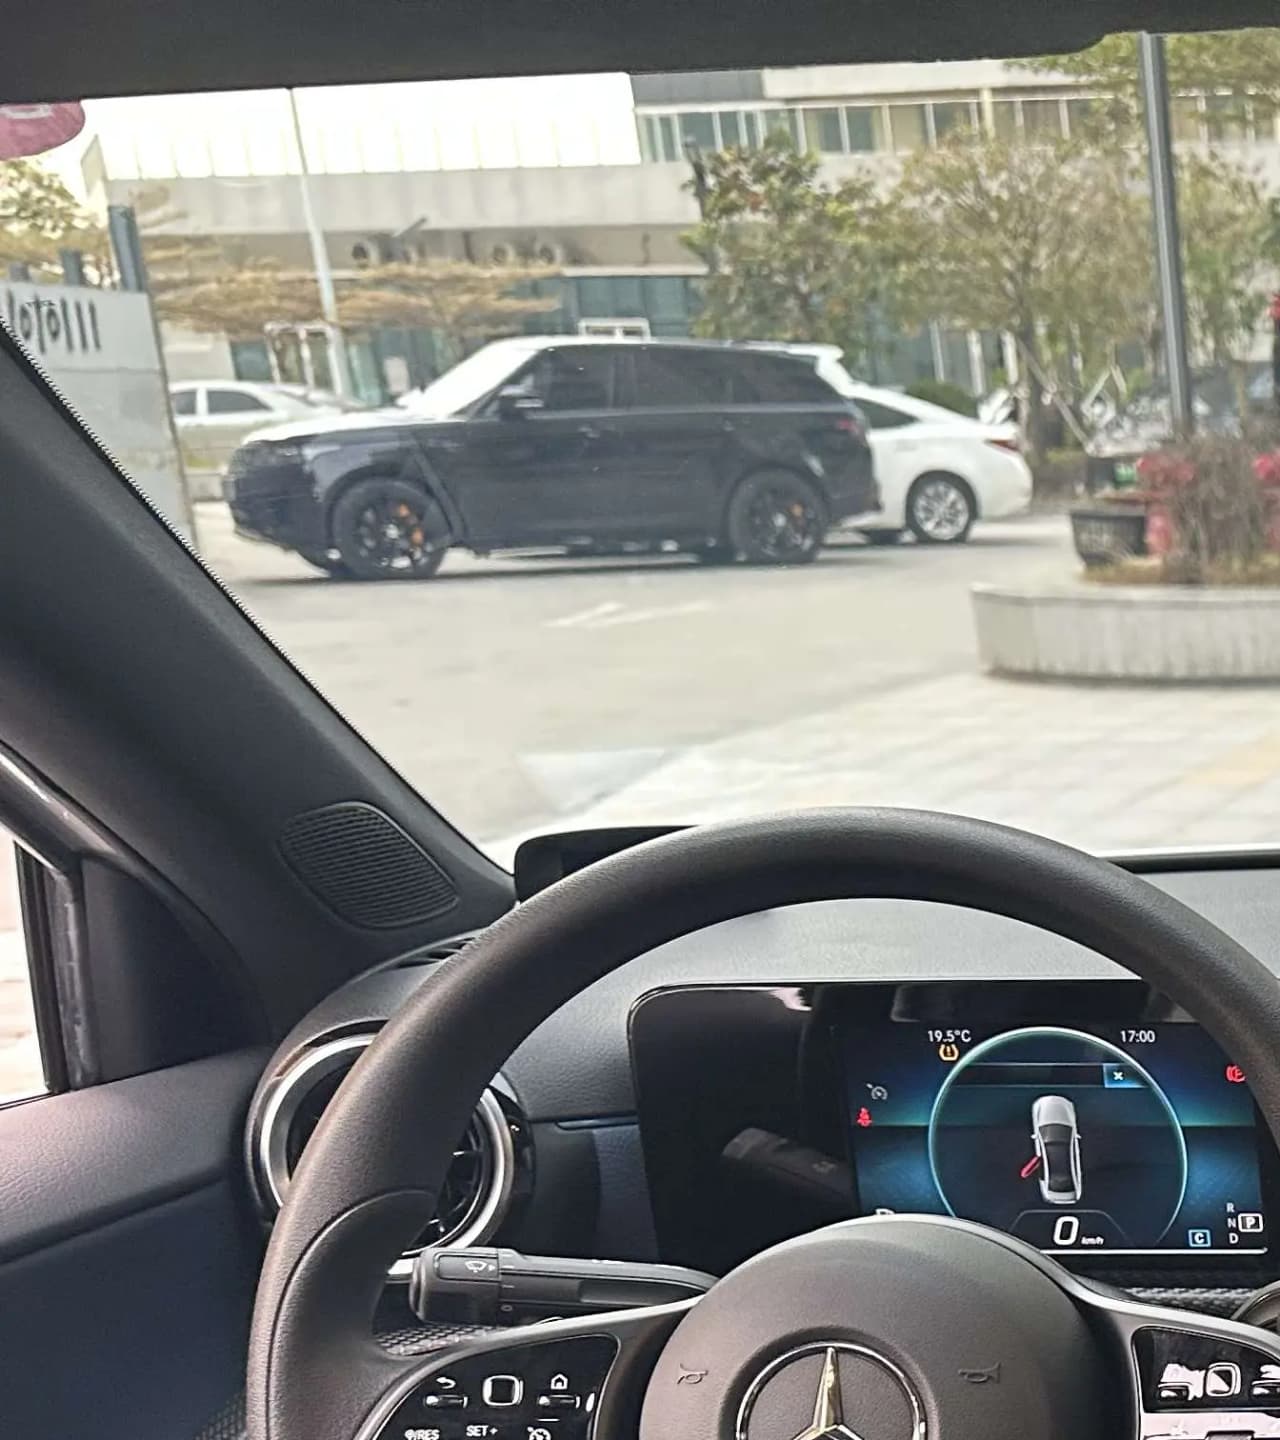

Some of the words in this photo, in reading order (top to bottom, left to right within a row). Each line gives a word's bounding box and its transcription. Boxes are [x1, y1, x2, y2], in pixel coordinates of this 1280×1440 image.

[928, 1029, 971, 1043] 19.5°C
[1120, 1029, 1156, 1043] 17:00
[1226, 1202, 1235, 1213] R
[1227, 1218, 1237, 1228] N
[1245, 1216, 1256, 1229] P
[1053, 1215, 1080, 1246] 0
[1229, 1233, 1239, 1244] D
